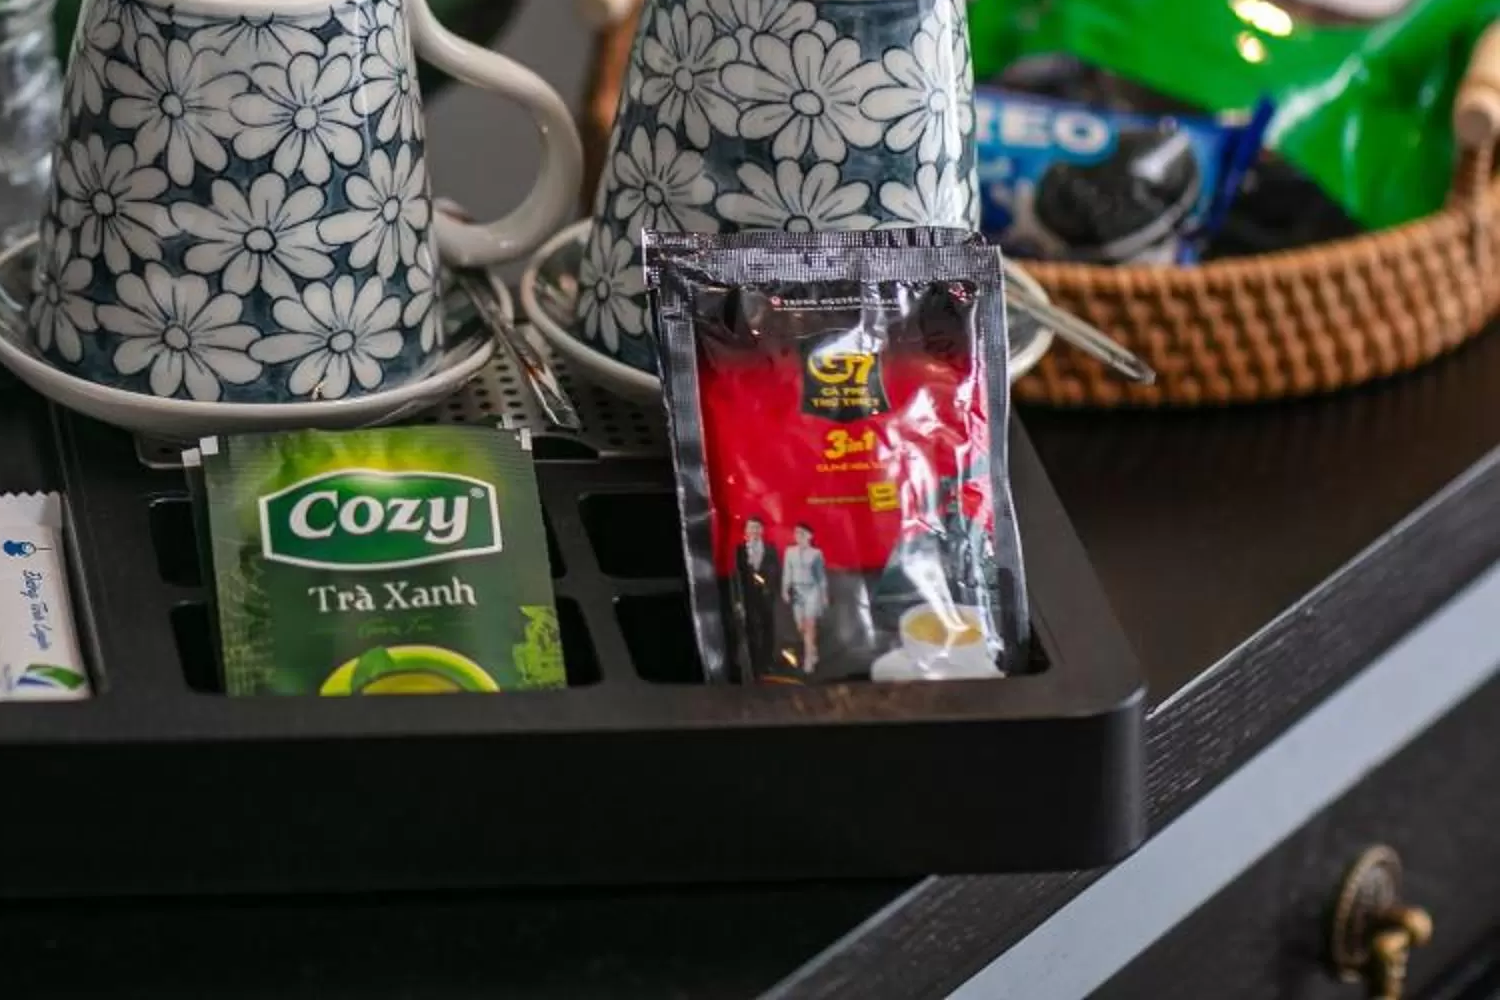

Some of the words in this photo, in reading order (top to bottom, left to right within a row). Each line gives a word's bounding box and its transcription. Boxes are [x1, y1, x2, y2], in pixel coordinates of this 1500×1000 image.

[288, 490, 469, 545] Cozy
[307, 583, 377, 614] Trà
[382, 575, 478, 611] Xanh
